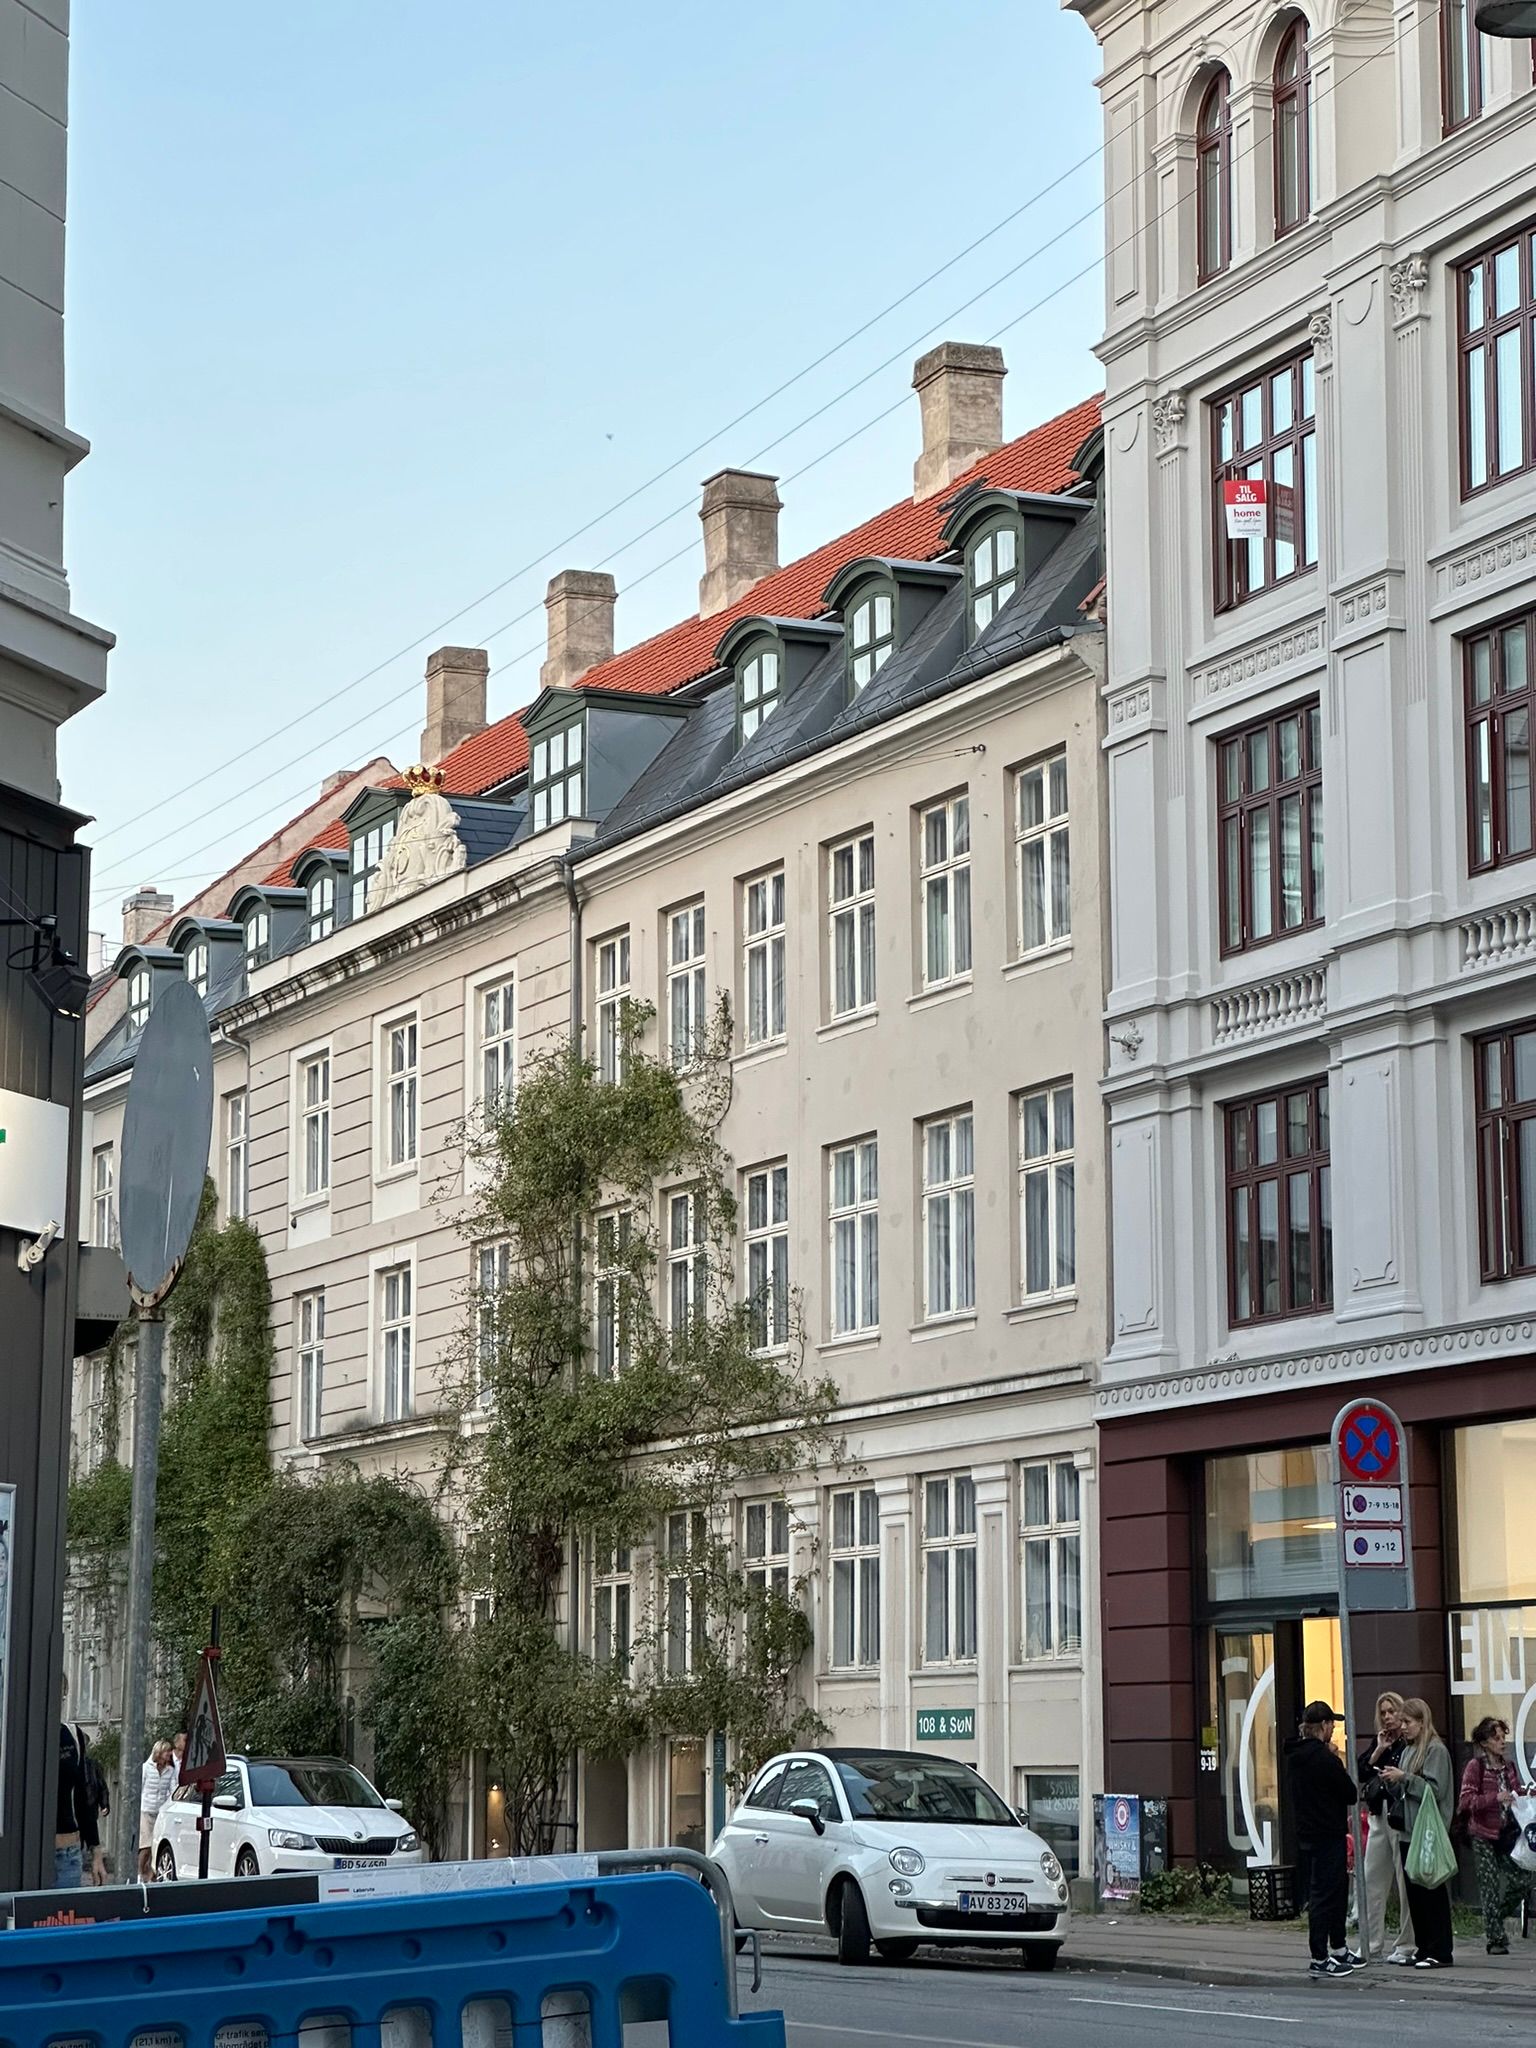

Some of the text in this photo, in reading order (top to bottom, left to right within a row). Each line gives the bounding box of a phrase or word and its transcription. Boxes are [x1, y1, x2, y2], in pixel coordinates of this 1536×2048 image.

[1239, 1485, 1252, 1493] TIL
[1235, 1493, 1257, 1502] SALG
[1233, 1508, 1261, 1517] home
[1374, 1542, 1396, 1551] 9-12
[919, 1716, 936, 1733] 108
[939, 1716, 947, 1733] &
[1200, 1756, 1217, 1771] 9-19
[341, 1860, 354, 1869] BD
[969, 1896, 1025, 1910] AV 83 294
[227, 2030, 250, 2039] trafik
